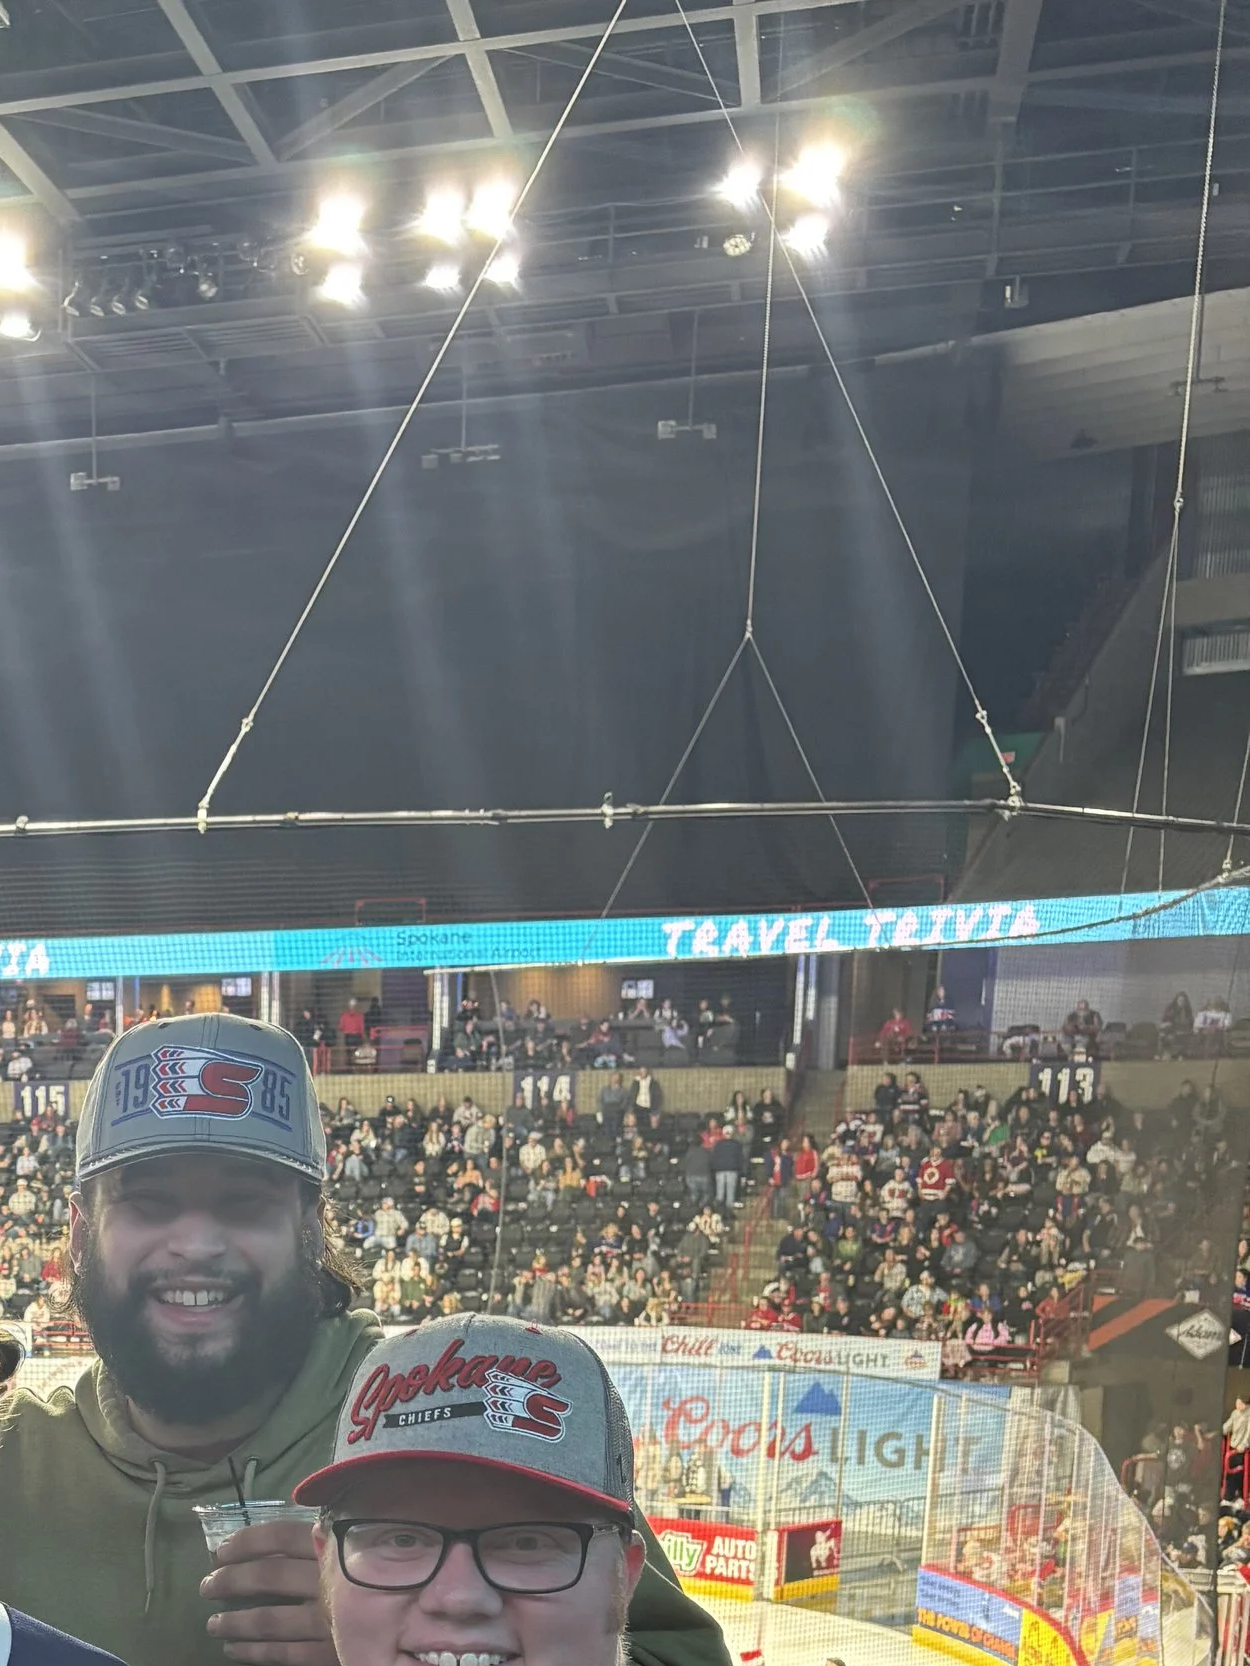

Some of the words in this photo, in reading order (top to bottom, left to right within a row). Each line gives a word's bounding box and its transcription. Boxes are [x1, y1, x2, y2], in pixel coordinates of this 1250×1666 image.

[662, 916, 839, 960] TRAVEL
[864, 905, 1041, 948] TRIVIA
[20, 1085, 66, 1117] 115
[121, 1063, 149, 1114] 19
[260, 1067, 291, 1121] 85
[1038, 1067, 1094, 1105] 113
[347, 1338, 563, 1445] Spokane
[397, 1407, 452, 1426] CHIEFS
[662, 1394, 819, 1463] Coors
[711, 1536, 757, 1561] AUTO
